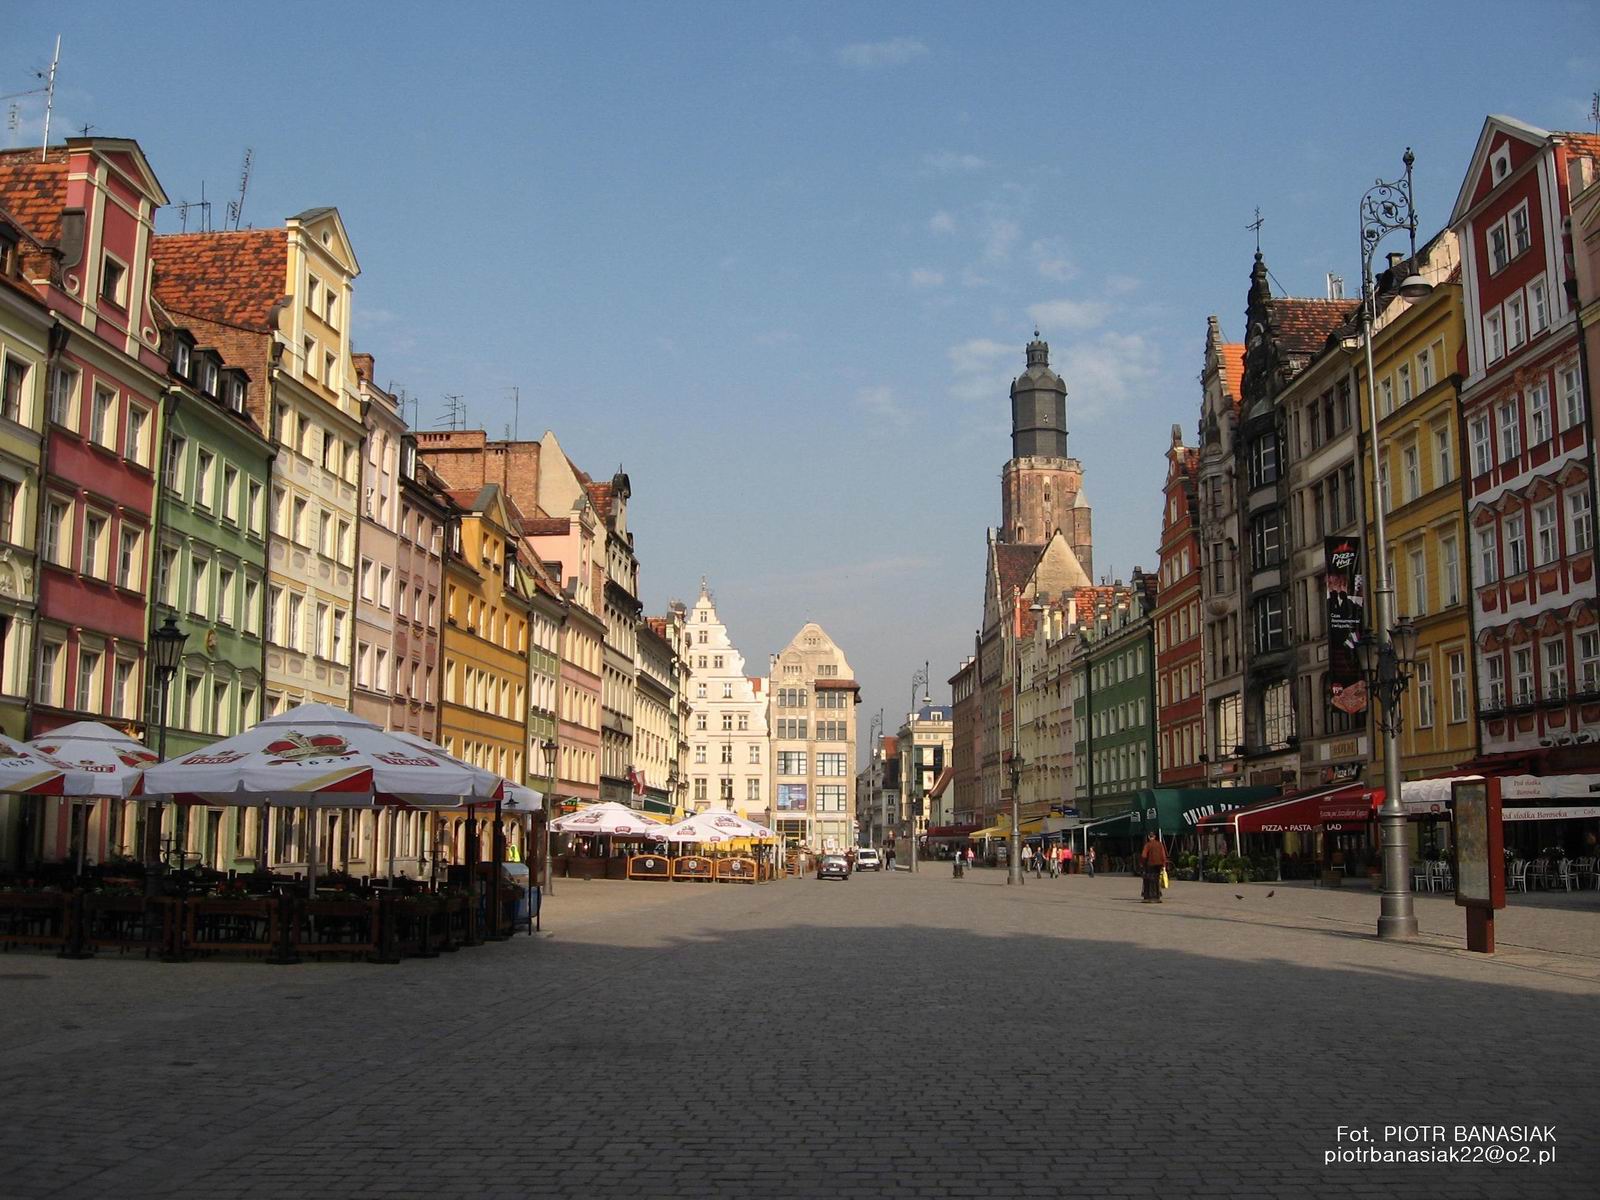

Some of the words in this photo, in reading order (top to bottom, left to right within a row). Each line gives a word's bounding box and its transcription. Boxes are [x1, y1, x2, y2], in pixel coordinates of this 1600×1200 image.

[1331, 552, 1355, 564] Pizza
[1336, 558, 1353, 568] Hut
[1, 759, 34, 768] 1629
[296, 756, 351, 767] 1629
[1182, 804, 1215, 825] UNION
[1261, 824, 1283, 832] PIZZA
[1289, 823, 1312, 832] PASTA
[1326, 823, 1342, 831] LAD
